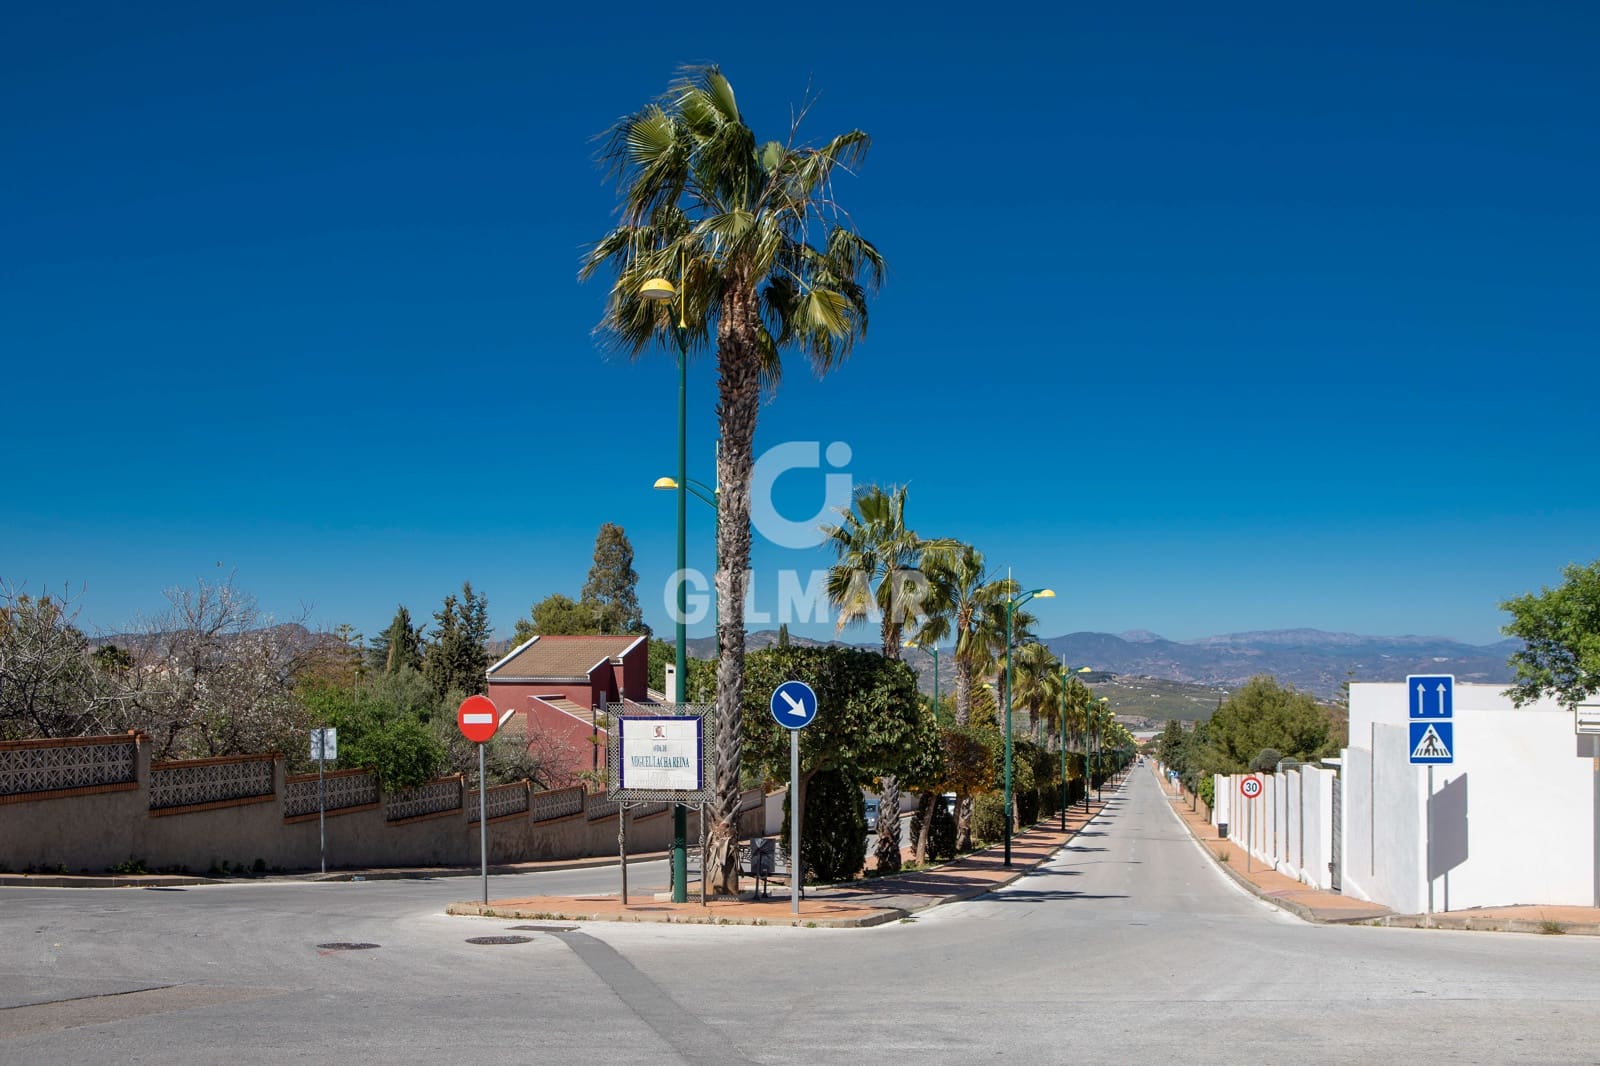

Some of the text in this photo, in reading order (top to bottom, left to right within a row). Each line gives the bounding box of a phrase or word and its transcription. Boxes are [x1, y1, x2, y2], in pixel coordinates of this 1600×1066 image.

[631, 755, 653, 768] MIGUEL
[672, 756, 690, 768] REINA
[1245, 782, 1258, 793] 30
